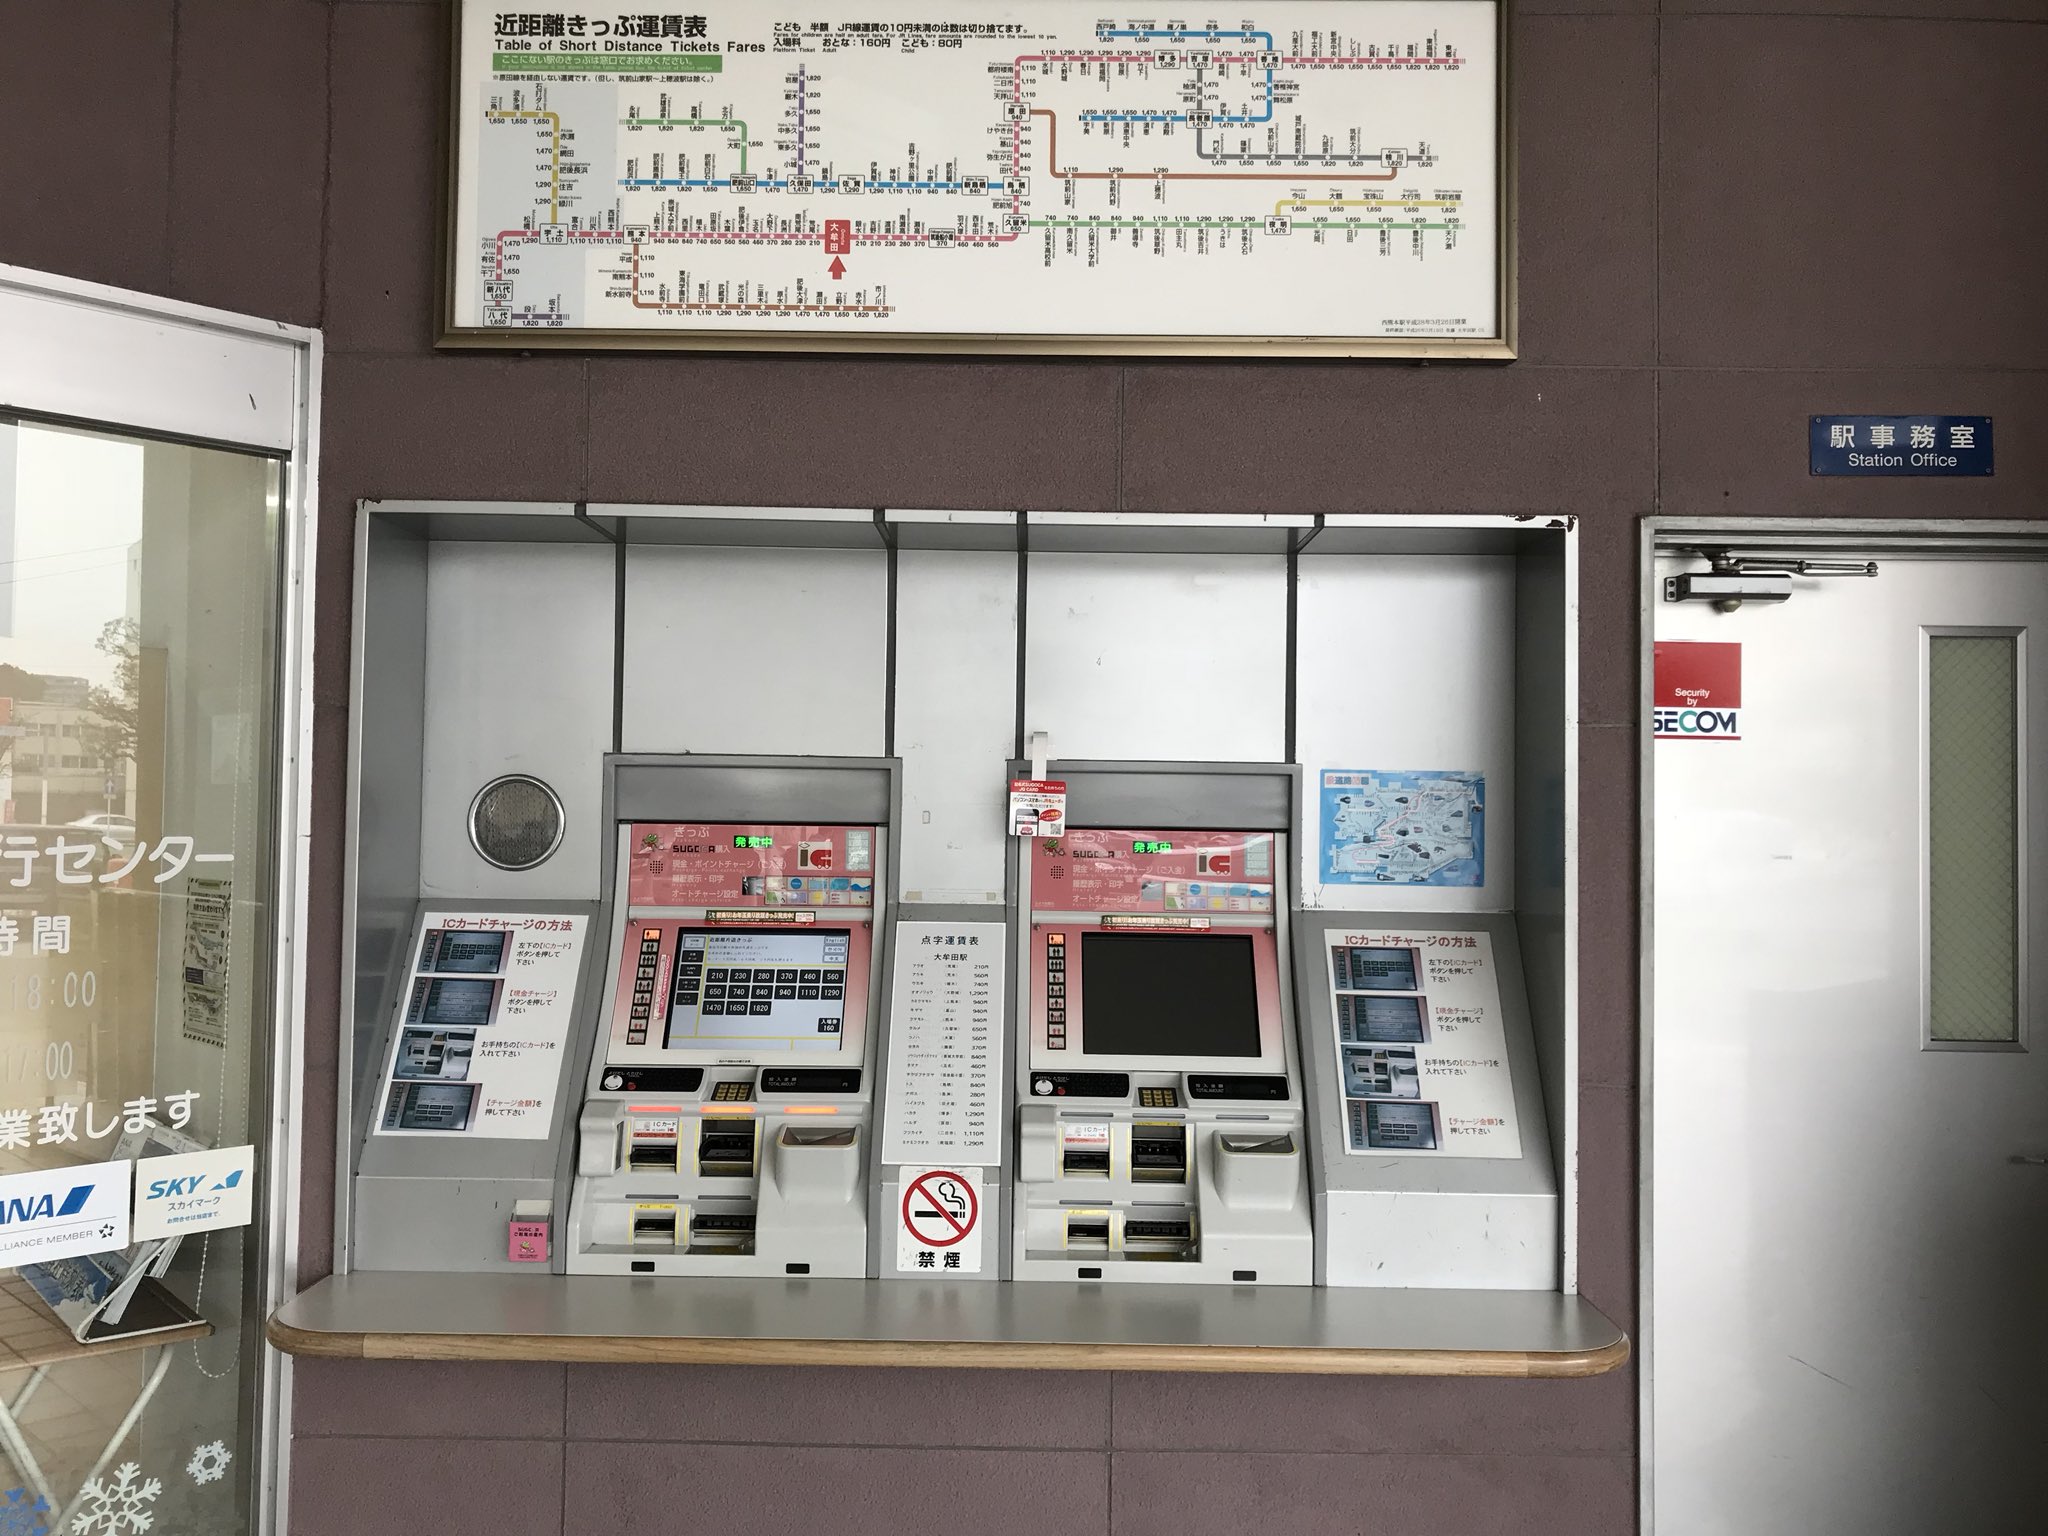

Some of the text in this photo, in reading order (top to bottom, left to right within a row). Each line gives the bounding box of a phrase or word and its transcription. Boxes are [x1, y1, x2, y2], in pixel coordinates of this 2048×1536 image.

[495, 13, 707, 40] 近距離きっぷ運賃表
[495, 40, 765, 52] Table of Short Distance Tickets Fares
[774, 39, 800, 48] 入場料
[501, 56, 693, 65] ここにない駅のきっぷは窓口でお求めください。
[544, 229, 563, 237] 宇土
[830, 223, 839, 252] 大牟田
[481, 241, 495, 249] 小川
[487, 286, 510, 294] 新八代
[488, 312, 508, 320] 八代
[1831, 425, 1974, 448] 駅事務室
[1849, 453, 1957, 466] Station Office
[1675, 688, 1710, 699] Security
[1687, 698, 1698, 706] by
[1654, 710, 1736, 733] SECOM
[674, 826, 710, 838] きっぷ
[736, 837, 772, 847] 発売中
[1134, 842, 1171, 853] 発売中
[442, 918, 573, 931] ICカードチャージの方法
[921, 936, 978, 945] 点字運賃表
[1345, 935, 1477, 948] ICカードチャージの方法
[1430, 967, 1473, 975] ボタンを押して
[508, 998, 552, 1006] ボタンを押して
[1437, 1016, 1481, 1024] ボタンを押して
[485, 1108, 525, 1116] 押して下さい
[0, 1090, 200, 1150] 業致します
[1451, 1127, 1490, 1135] 押して下さい
[146, 1175, 207, 1200] SKY
[0, 1194, 54, 1225] NA
[168, 1197, 221, 1211] スカイマーク
[0, 1230, 93, 1251] LIANCE MEMBER
[919, 1251, 960, 1268] 禁煙
